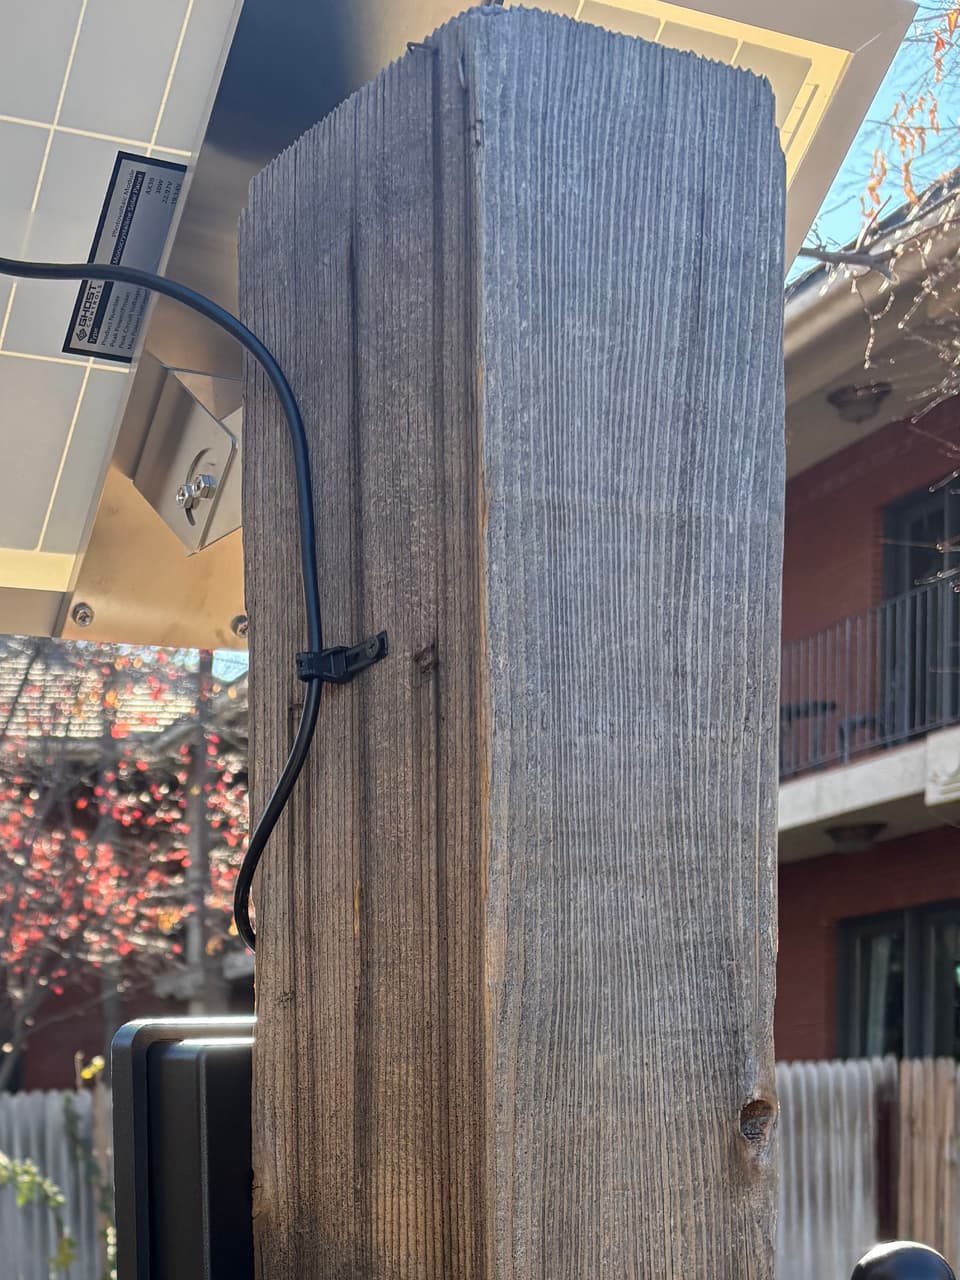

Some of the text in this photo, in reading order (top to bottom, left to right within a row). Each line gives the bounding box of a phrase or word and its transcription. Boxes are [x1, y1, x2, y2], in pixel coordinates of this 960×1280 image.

[111, 169, 135, 238] Photovoltaic Module
[128, 194, 138, 211] Solar
[133, 174, 144, 194] Panel
[86, 284, 102, 328] CONTROLS
